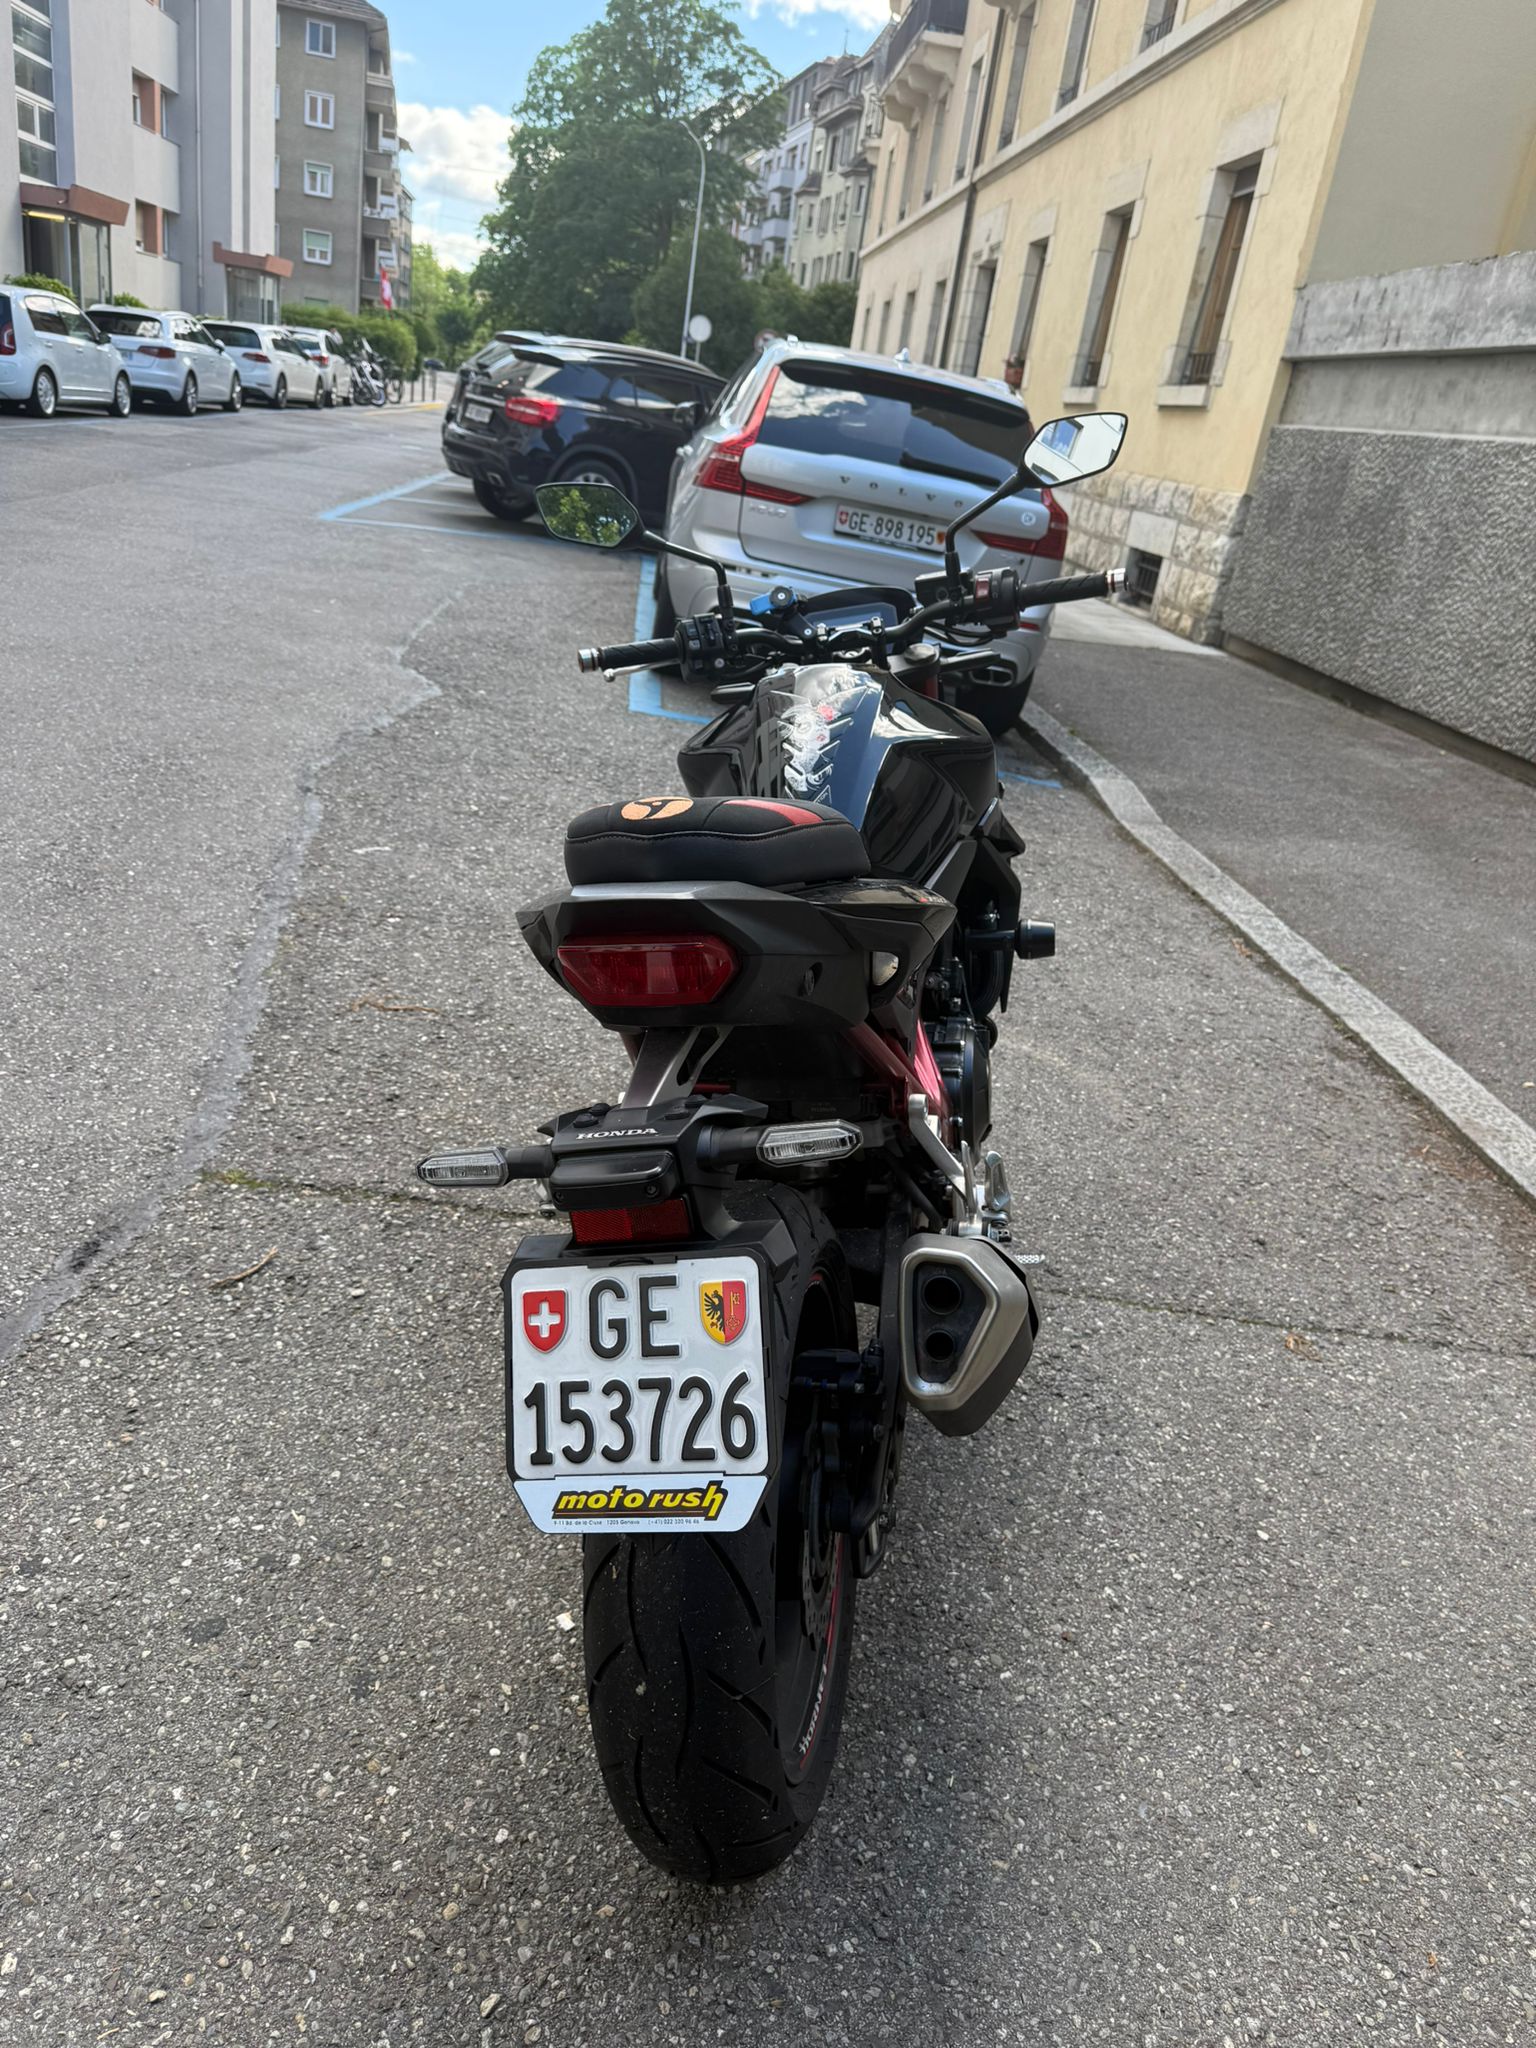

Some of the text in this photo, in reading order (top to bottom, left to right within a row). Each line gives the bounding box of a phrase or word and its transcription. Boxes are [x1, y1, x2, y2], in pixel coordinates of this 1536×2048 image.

[840, 476, 963, 508] VOLVO
[576, 1128, 658, 1140] HONDA
[588, 1275, 681, 1360] GE
[524, 1371, 756, 1465] 153726
